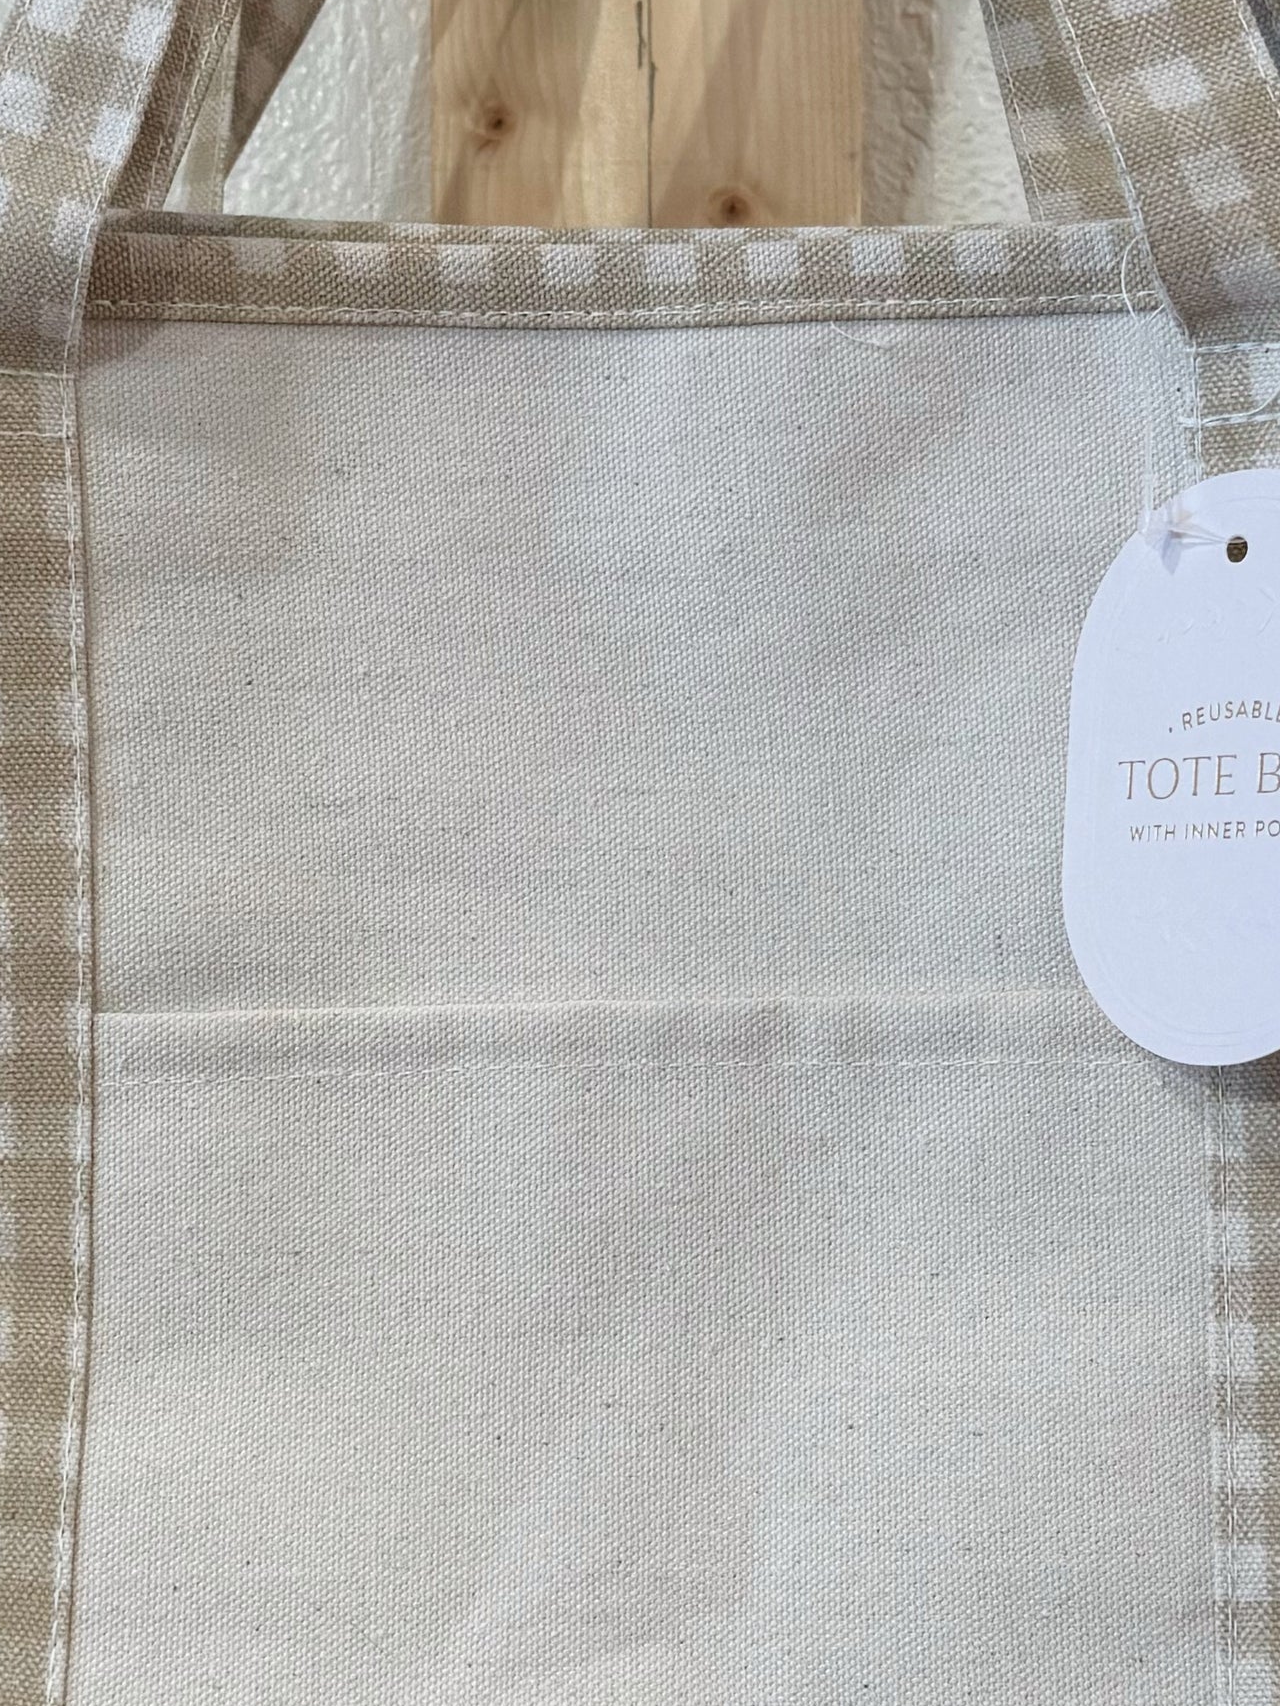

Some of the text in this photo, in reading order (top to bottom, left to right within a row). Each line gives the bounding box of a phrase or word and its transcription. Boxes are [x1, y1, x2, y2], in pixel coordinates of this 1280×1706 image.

[1118, 754, 1237, 800] TOTE
[1130, 824, 1176, 842] WITH
[1185, 822, 1246, 839] INNER
